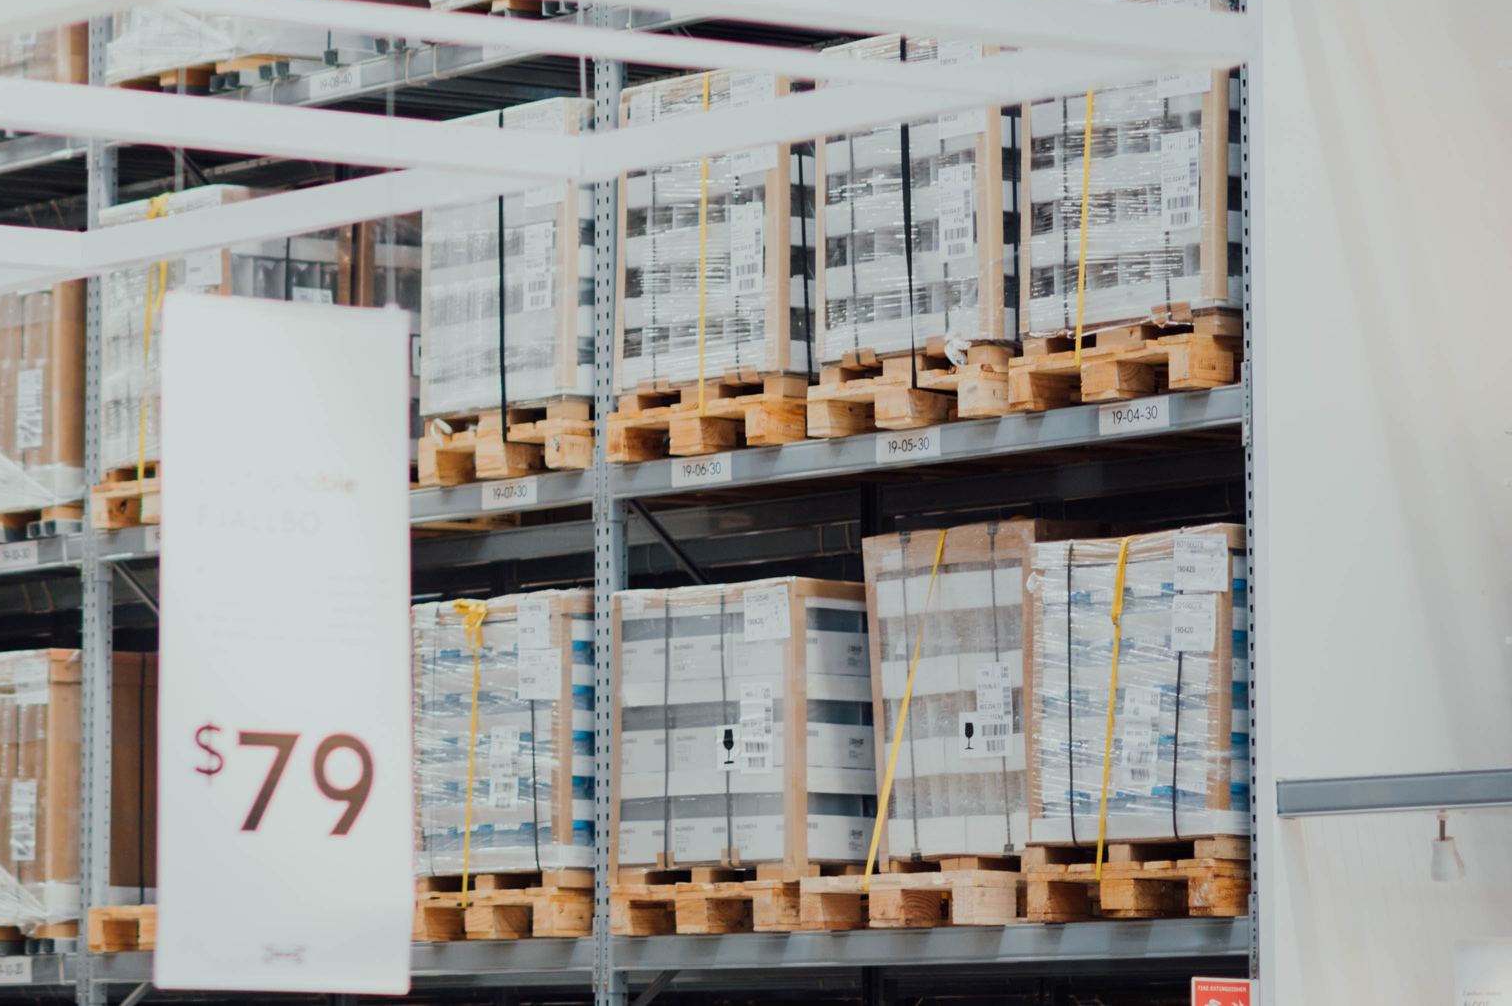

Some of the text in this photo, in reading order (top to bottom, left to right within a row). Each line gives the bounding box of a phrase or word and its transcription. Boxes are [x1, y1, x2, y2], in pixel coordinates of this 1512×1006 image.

[1112, 405, 1158, 425] 19-04-30
[888, 436, 930, 454] 19-05-30
[682, 461, 722, 478] 19-06-30
[492, 484, 528, 501] 19-07-30
[194, 723, 374, 837] $79
